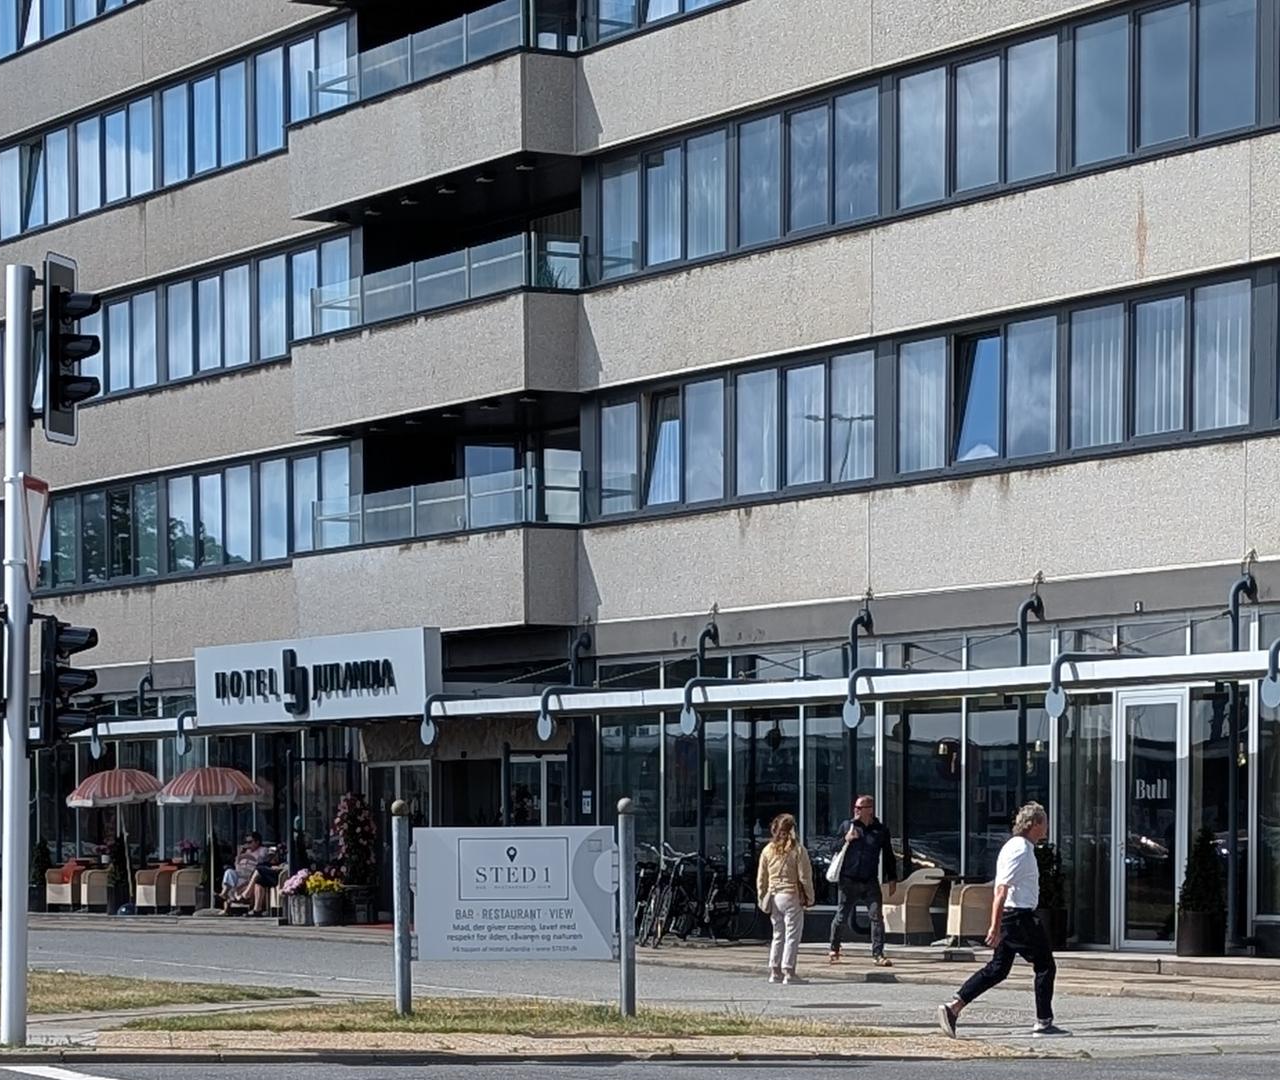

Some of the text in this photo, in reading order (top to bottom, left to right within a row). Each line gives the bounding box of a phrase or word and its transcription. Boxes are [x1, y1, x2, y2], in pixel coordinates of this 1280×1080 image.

[215, 667, 279, 699] HOTEL
[311, 659, 396, 701] JUTLANDIA
[1135, 778, 1168, 800] Bull
[475, 866, 551, 883] STED 1
[455, 908, 574, 920] BAR RESTAURANT VIEW
